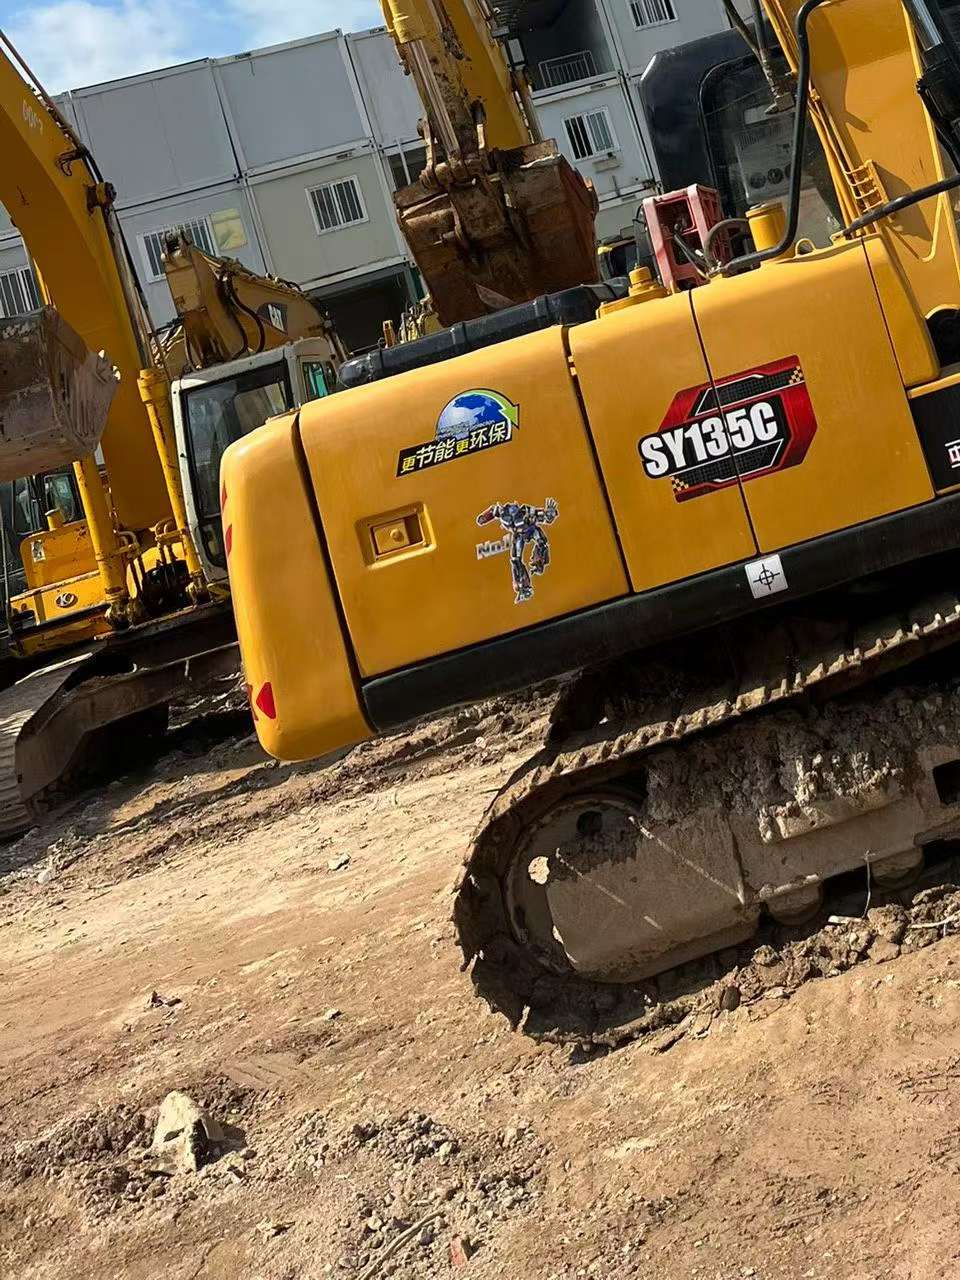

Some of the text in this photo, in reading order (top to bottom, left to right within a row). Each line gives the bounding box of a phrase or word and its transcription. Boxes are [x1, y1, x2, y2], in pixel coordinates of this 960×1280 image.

[400, 421, 506, 474] 更节能更环保
[640, 401, 778, 476] SY135C
